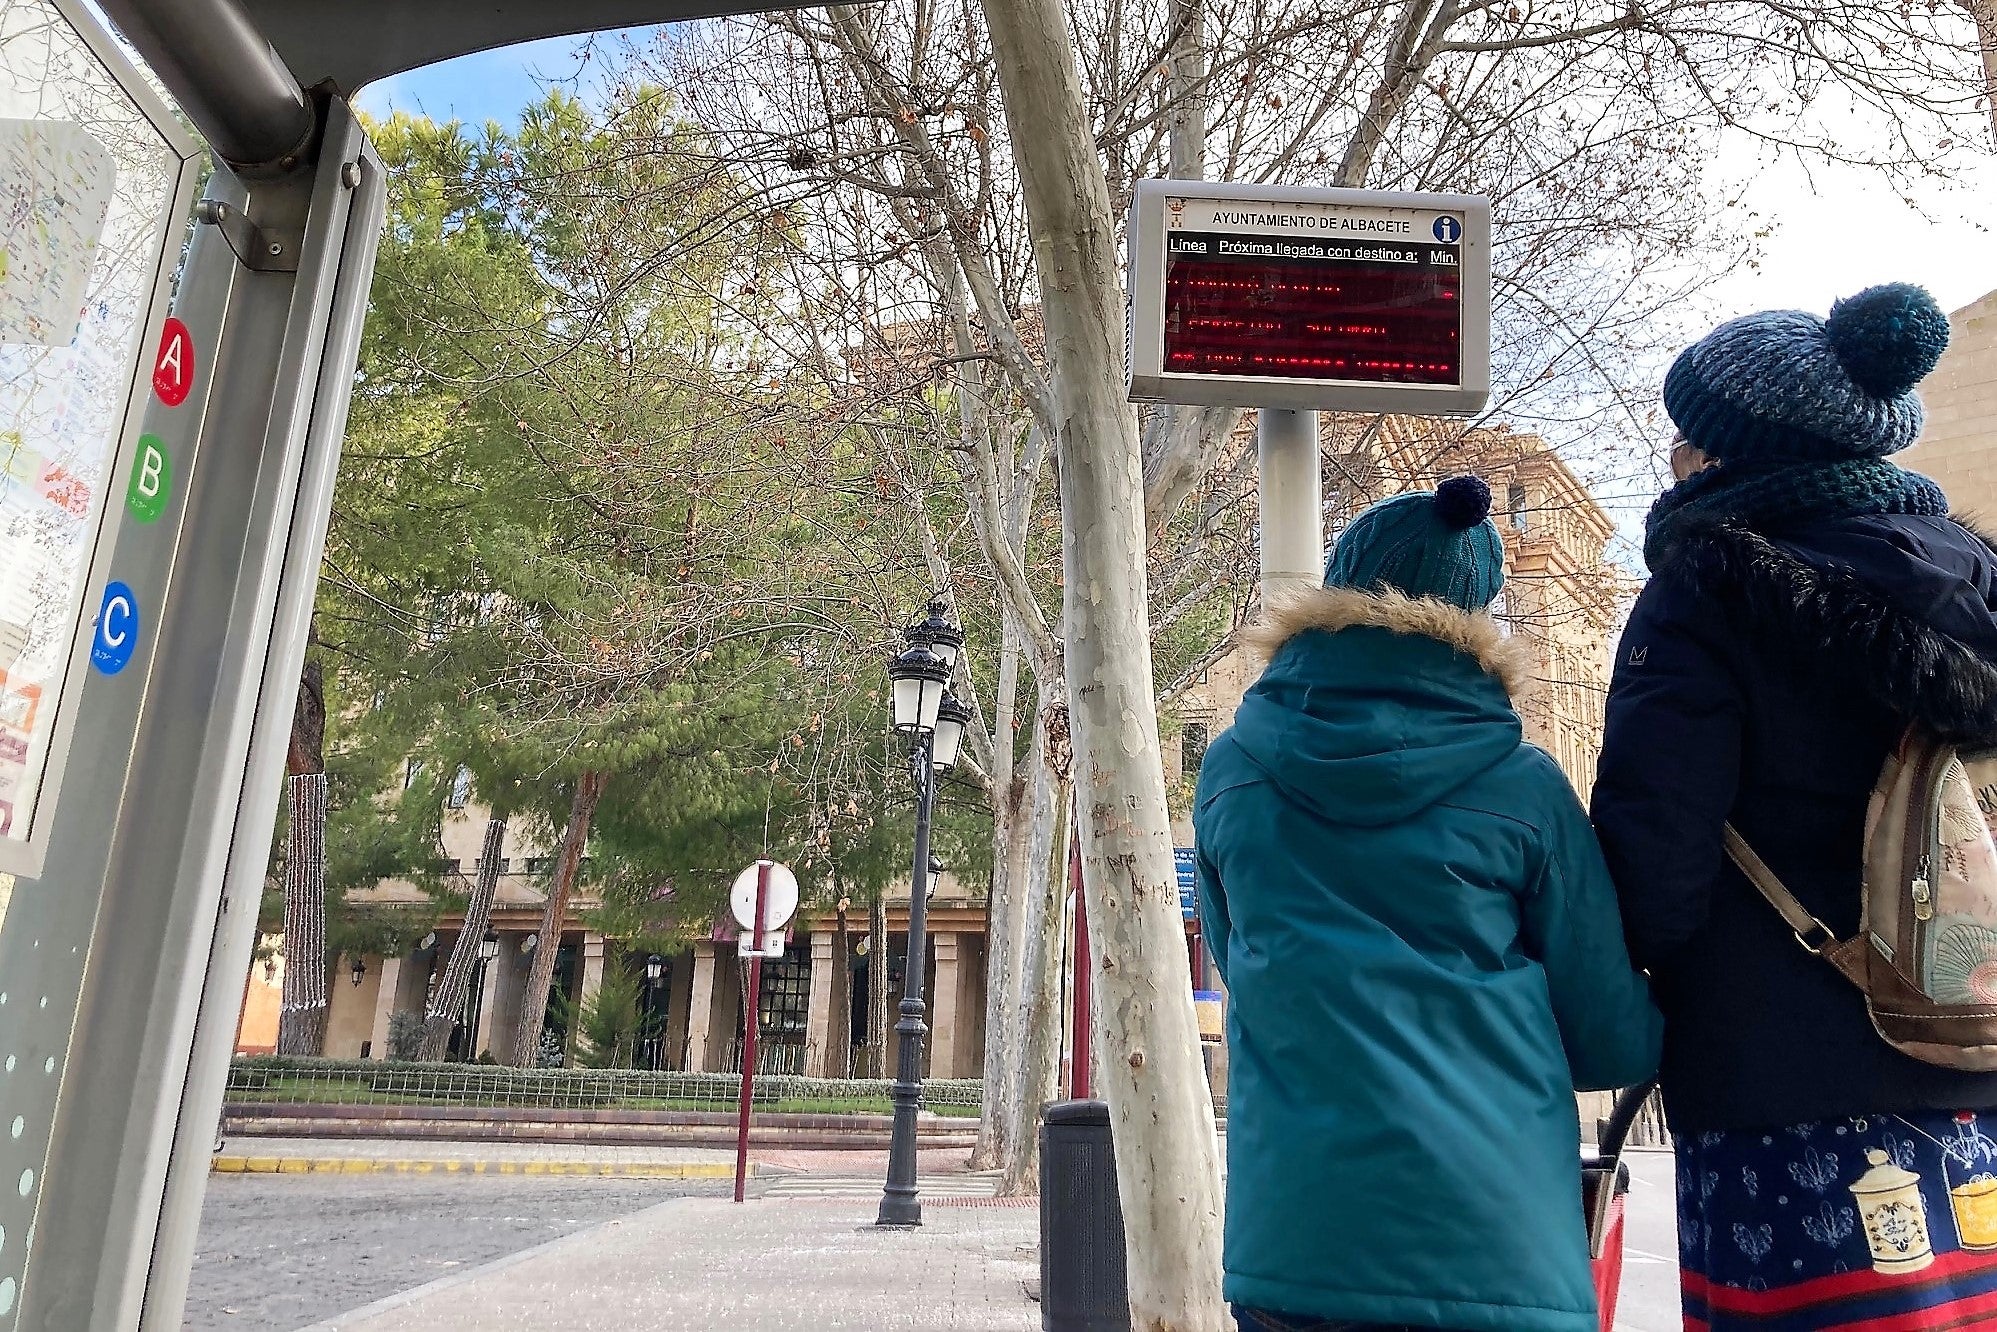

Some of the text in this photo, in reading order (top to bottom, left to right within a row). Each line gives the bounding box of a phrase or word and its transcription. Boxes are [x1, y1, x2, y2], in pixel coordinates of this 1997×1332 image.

[1212, 211, 1410, 233] AYUNTAMIENTO DE ALBACETE
[1219, 240, 1418, 262] Próxima llegada con destino a:
[160, 334, 182, 385] A
[138, 445, 162, 498] B
[104, 596, 130, 647] C
